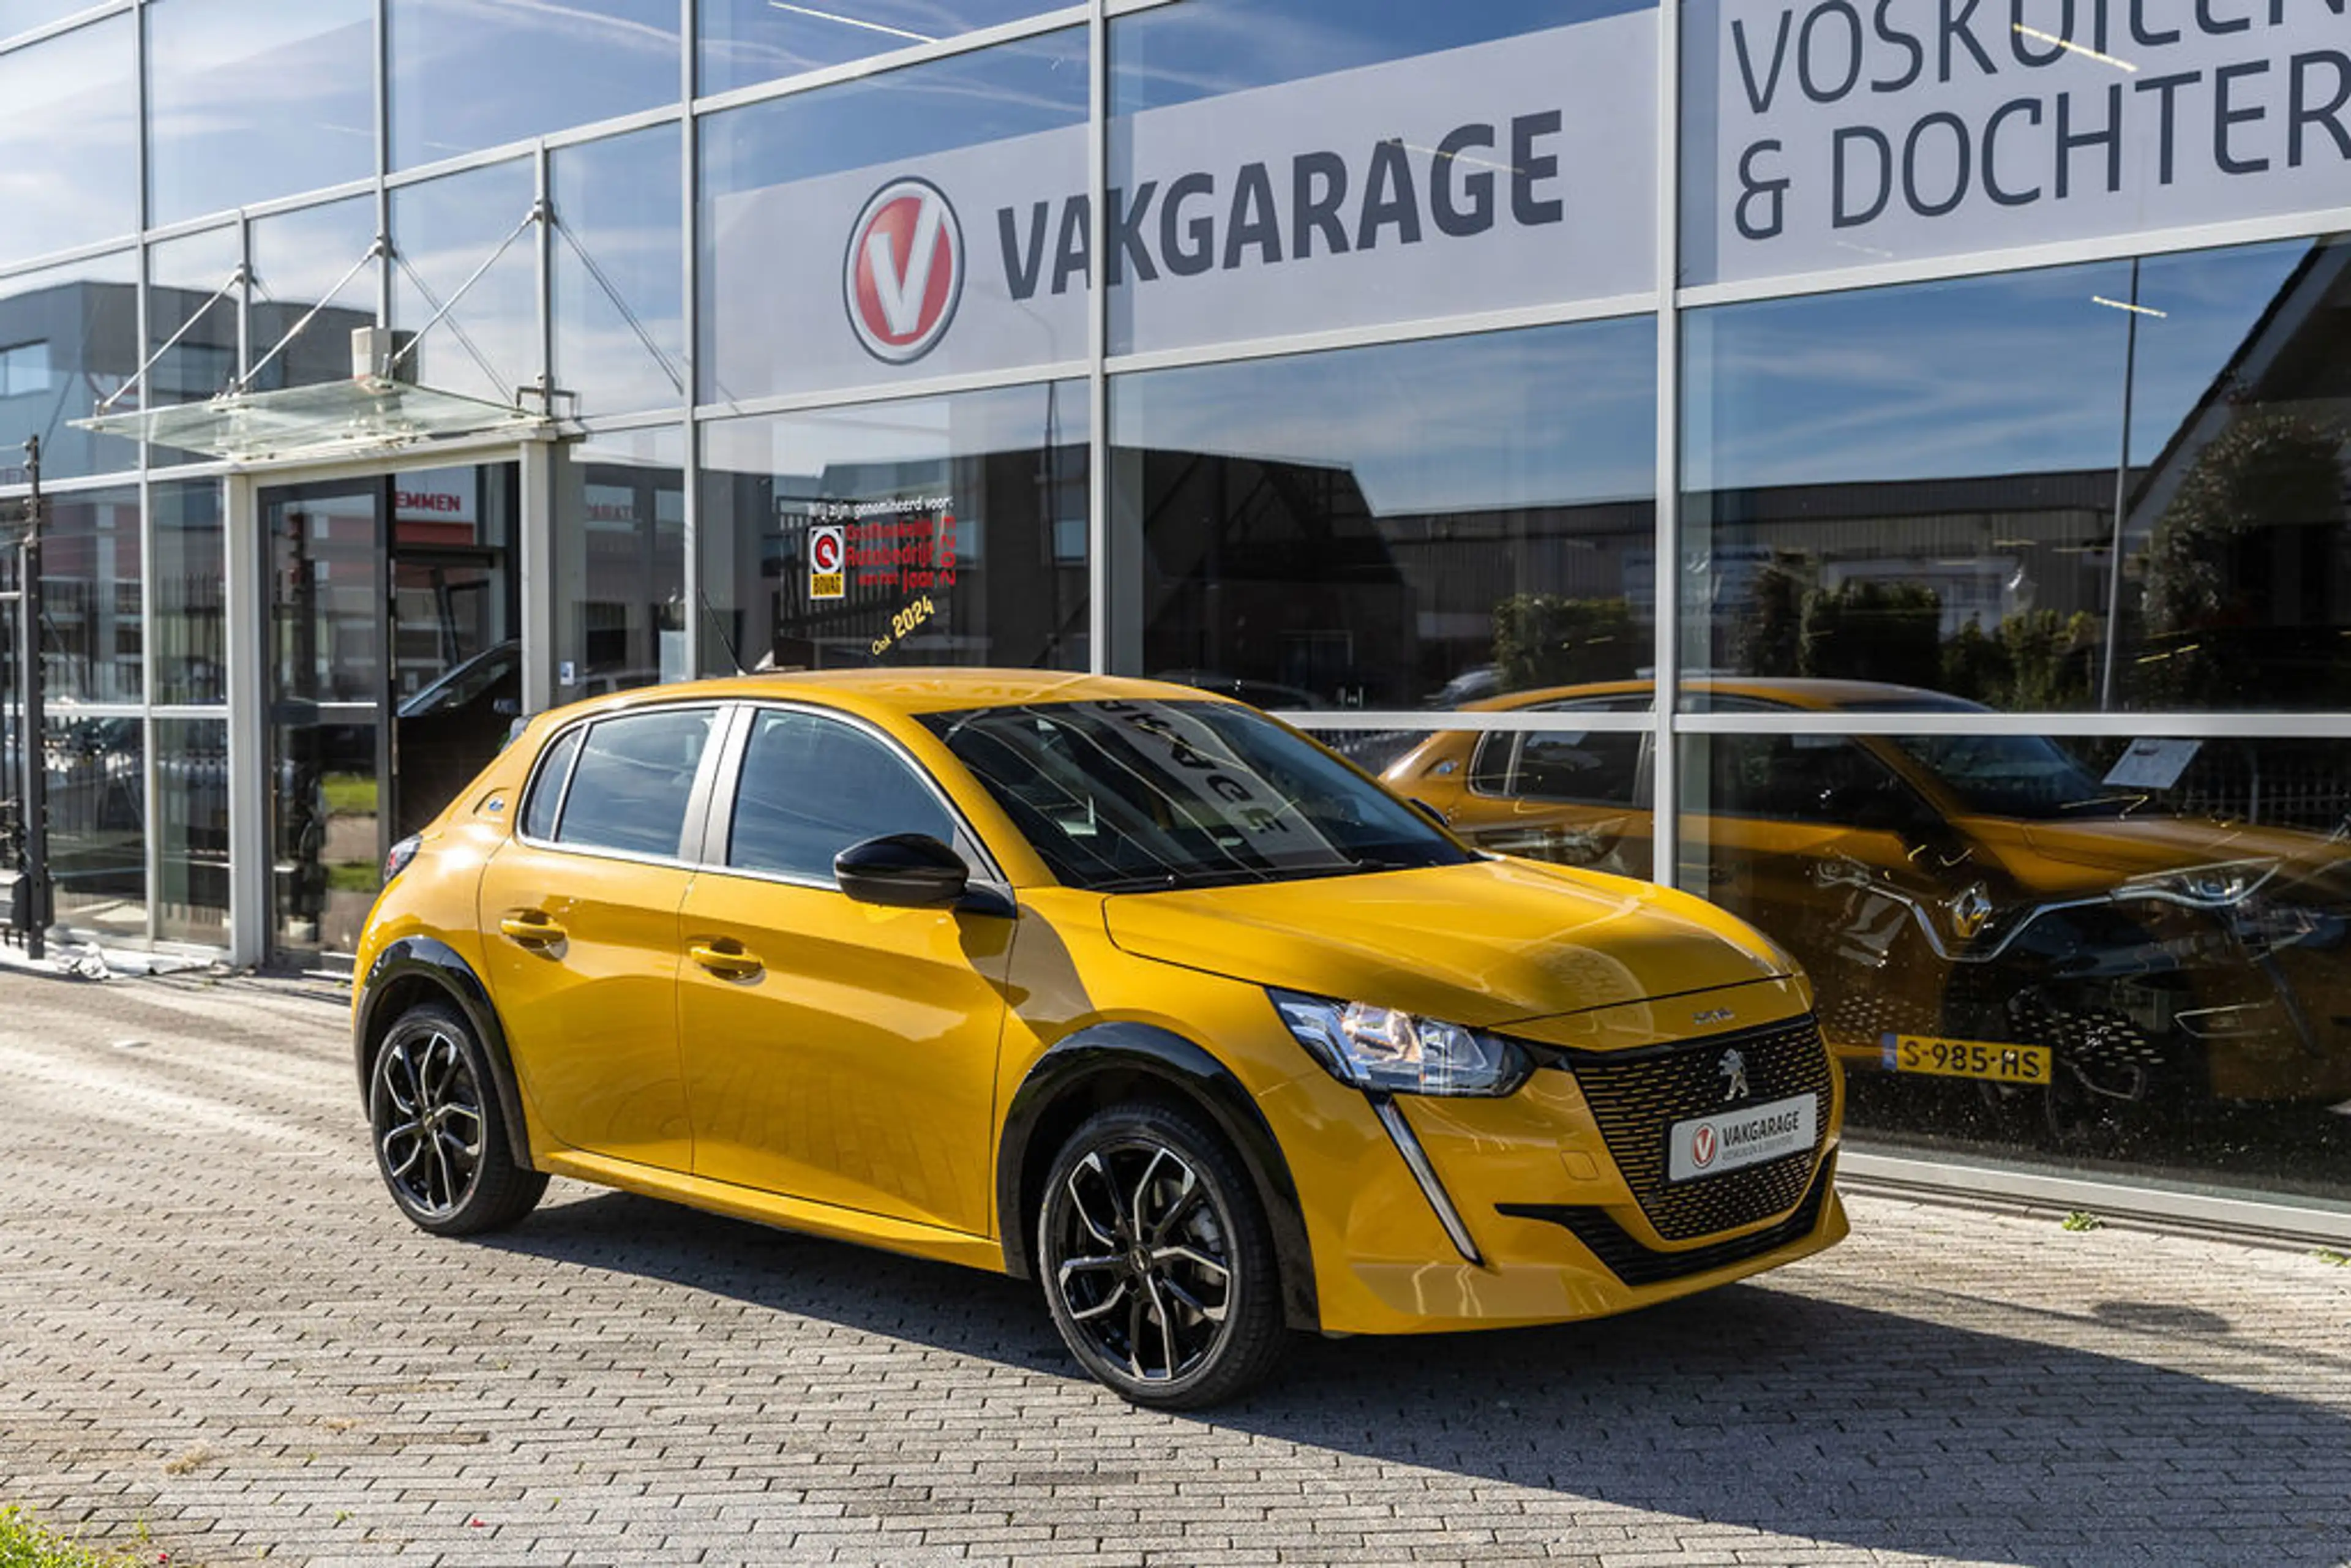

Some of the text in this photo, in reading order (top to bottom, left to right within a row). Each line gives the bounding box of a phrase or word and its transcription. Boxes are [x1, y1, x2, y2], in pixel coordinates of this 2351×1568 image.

[998, 110, 1562, 300] VAKGARAGE
[1734, 139, 1791, 241] &
[893, 595, 935, 638] 2024
[1903, 1040, 2039, 1078] S-985-HS
[1723, 1111, 1800, 1147] VAKGARAGE
